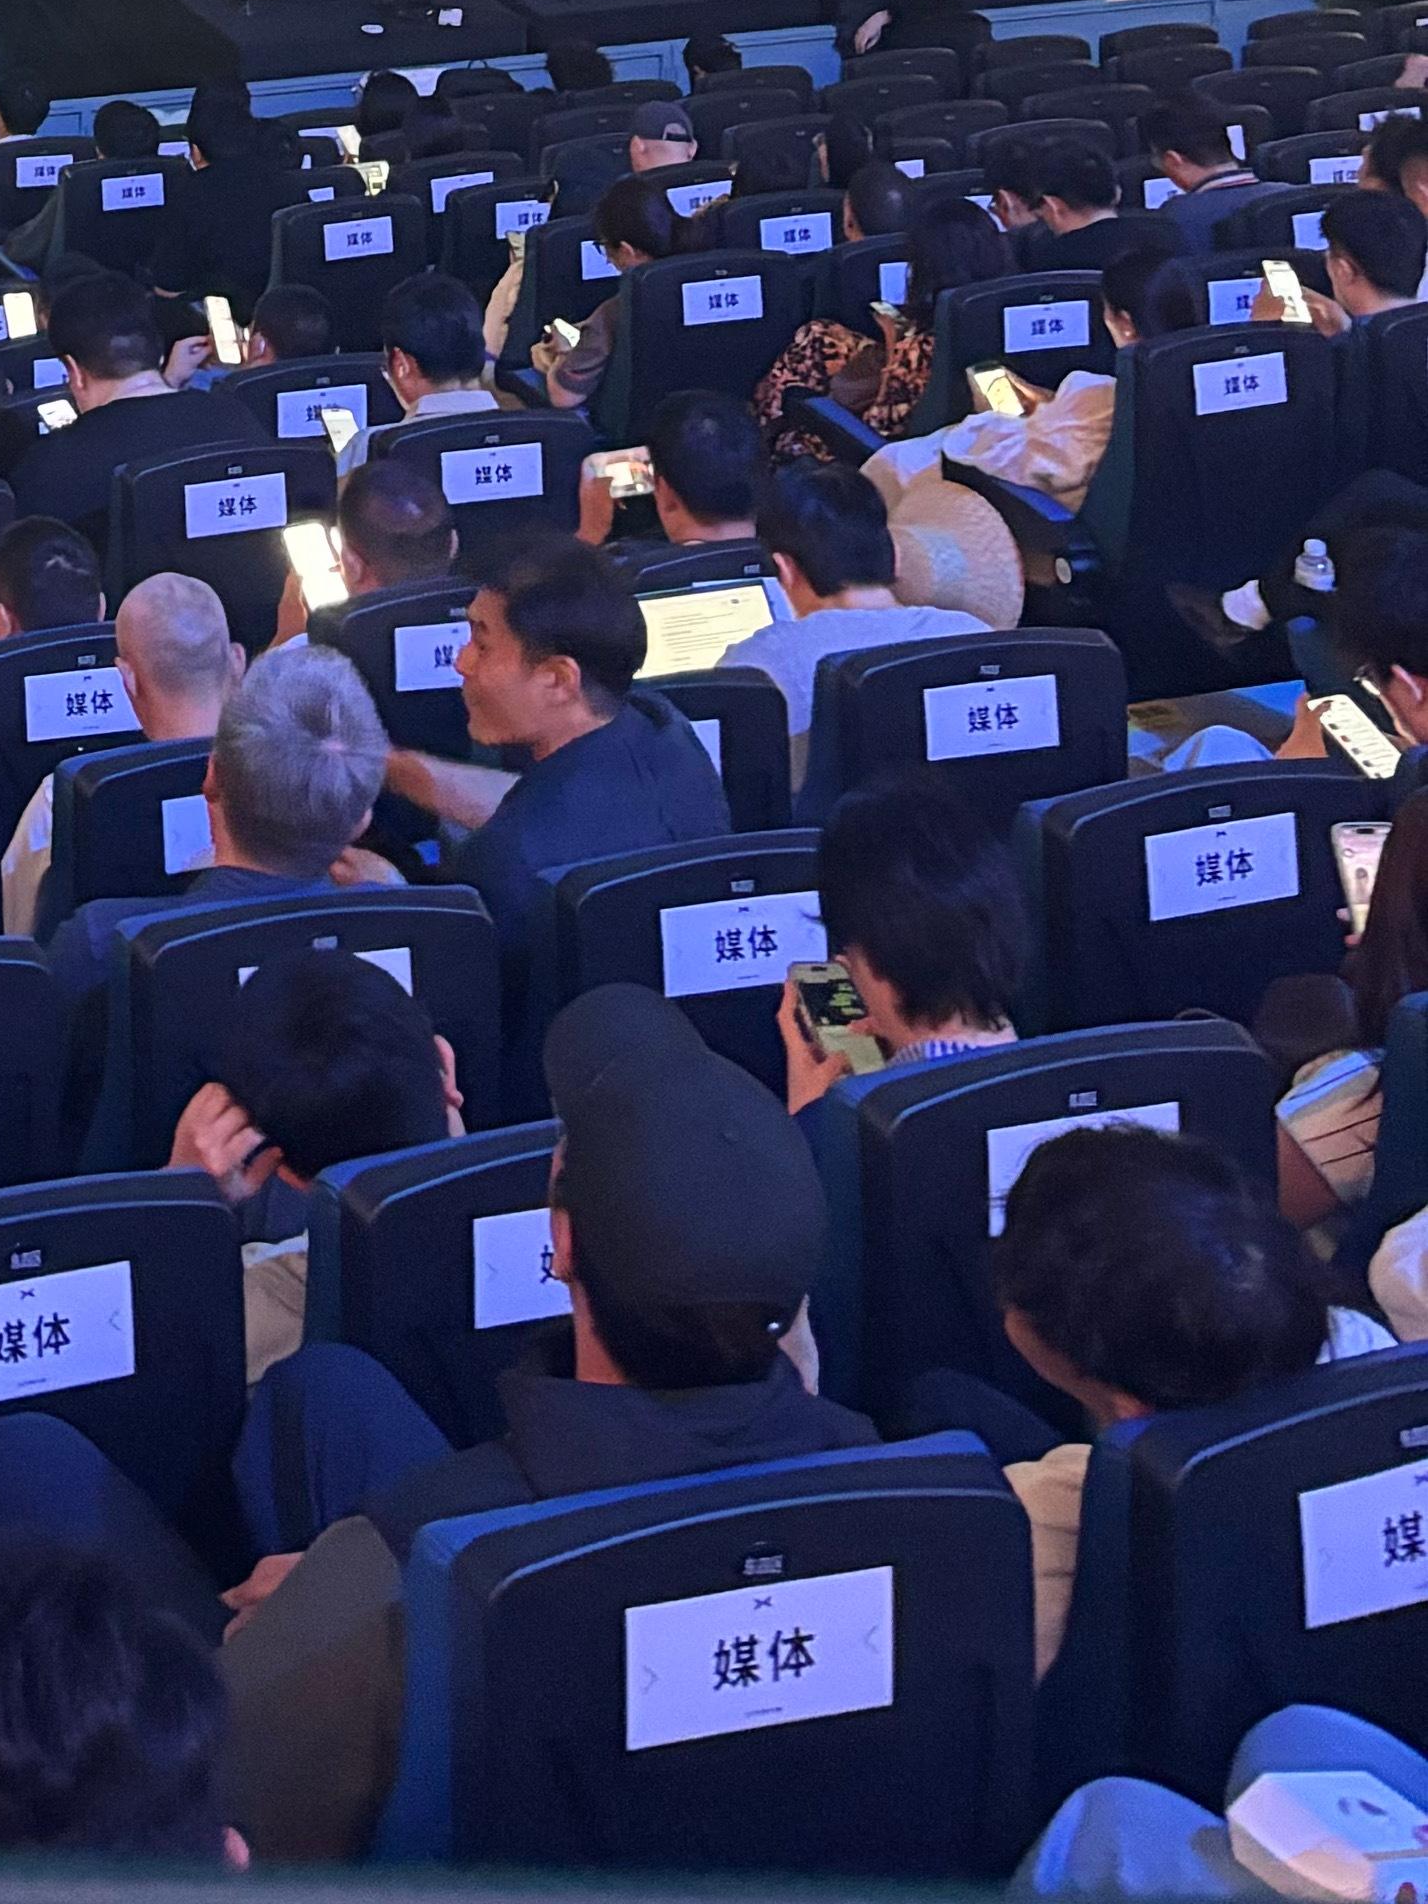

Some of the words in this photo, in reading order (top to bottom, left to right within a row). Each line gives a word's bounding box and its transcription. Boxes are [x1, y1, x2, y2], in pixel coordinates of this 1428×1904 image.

[709, 293, 739, 310] 媒体
[1031, 319, 1064, 336] 媒体
[1224, 376, 1259, 395] 媒体
[475, 464, 512, 485] 媒体
[218, 496, 257, 517] 媒体
[66, 690, 114, 716] 媒体
[968, 703, 1019, 732] 媒体
[1195, 848, 1253, 886] 媒体
[715, 926, 779, 963] 媒体
[1382, 1511, 1420, 1567] 媒
[713, 1627, 814, 1691] 媒体
